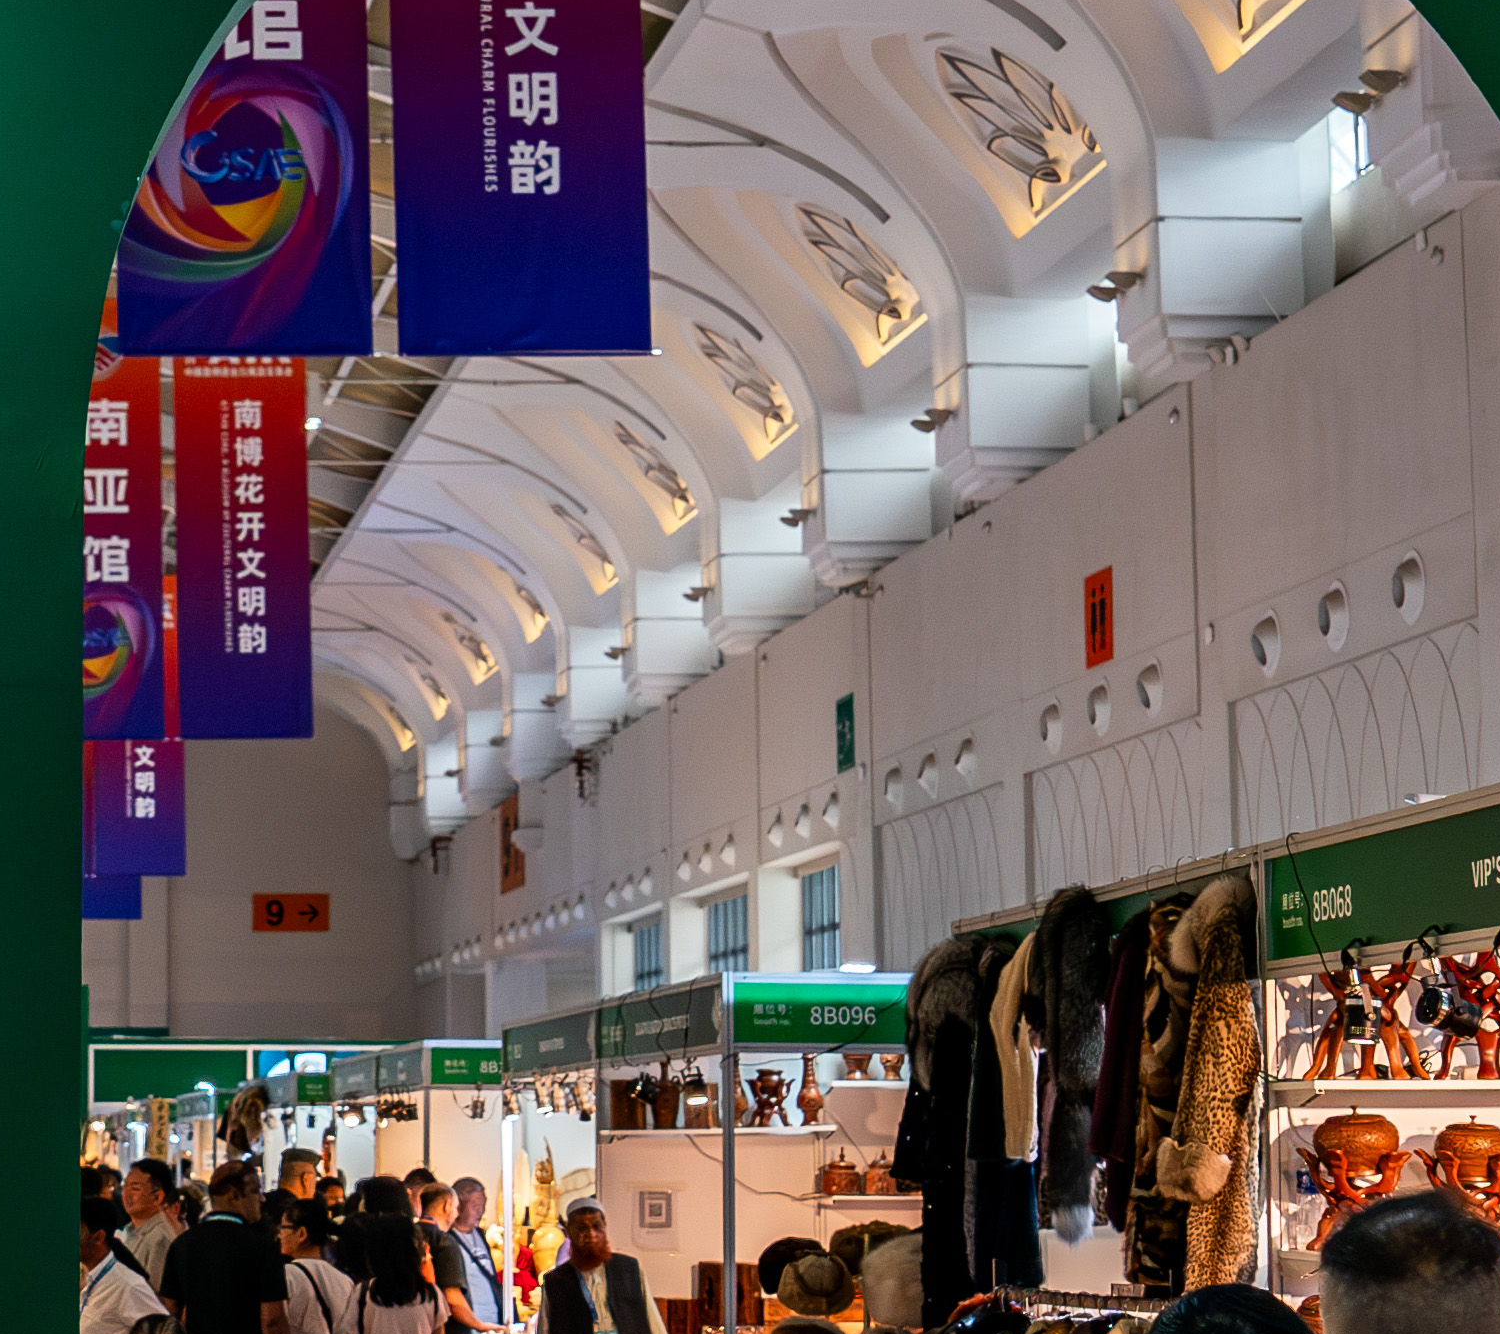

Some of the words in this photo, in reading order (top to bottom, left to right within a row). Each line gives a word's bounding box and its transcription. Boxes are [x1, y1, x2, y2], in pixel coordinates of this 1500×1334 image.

[480, 38, 496, 92] CHARM
[482, 98, 499, 193] FLOURISHES
[83, 398, 131, 584] 南亚馆
[232, 398, 268, 655] 南博花开文明韵
[265, 899, 284, 926] 9
[1312, 884, 1353, 923] 8B068
[810, 1005, 877, 1026] 8B096
